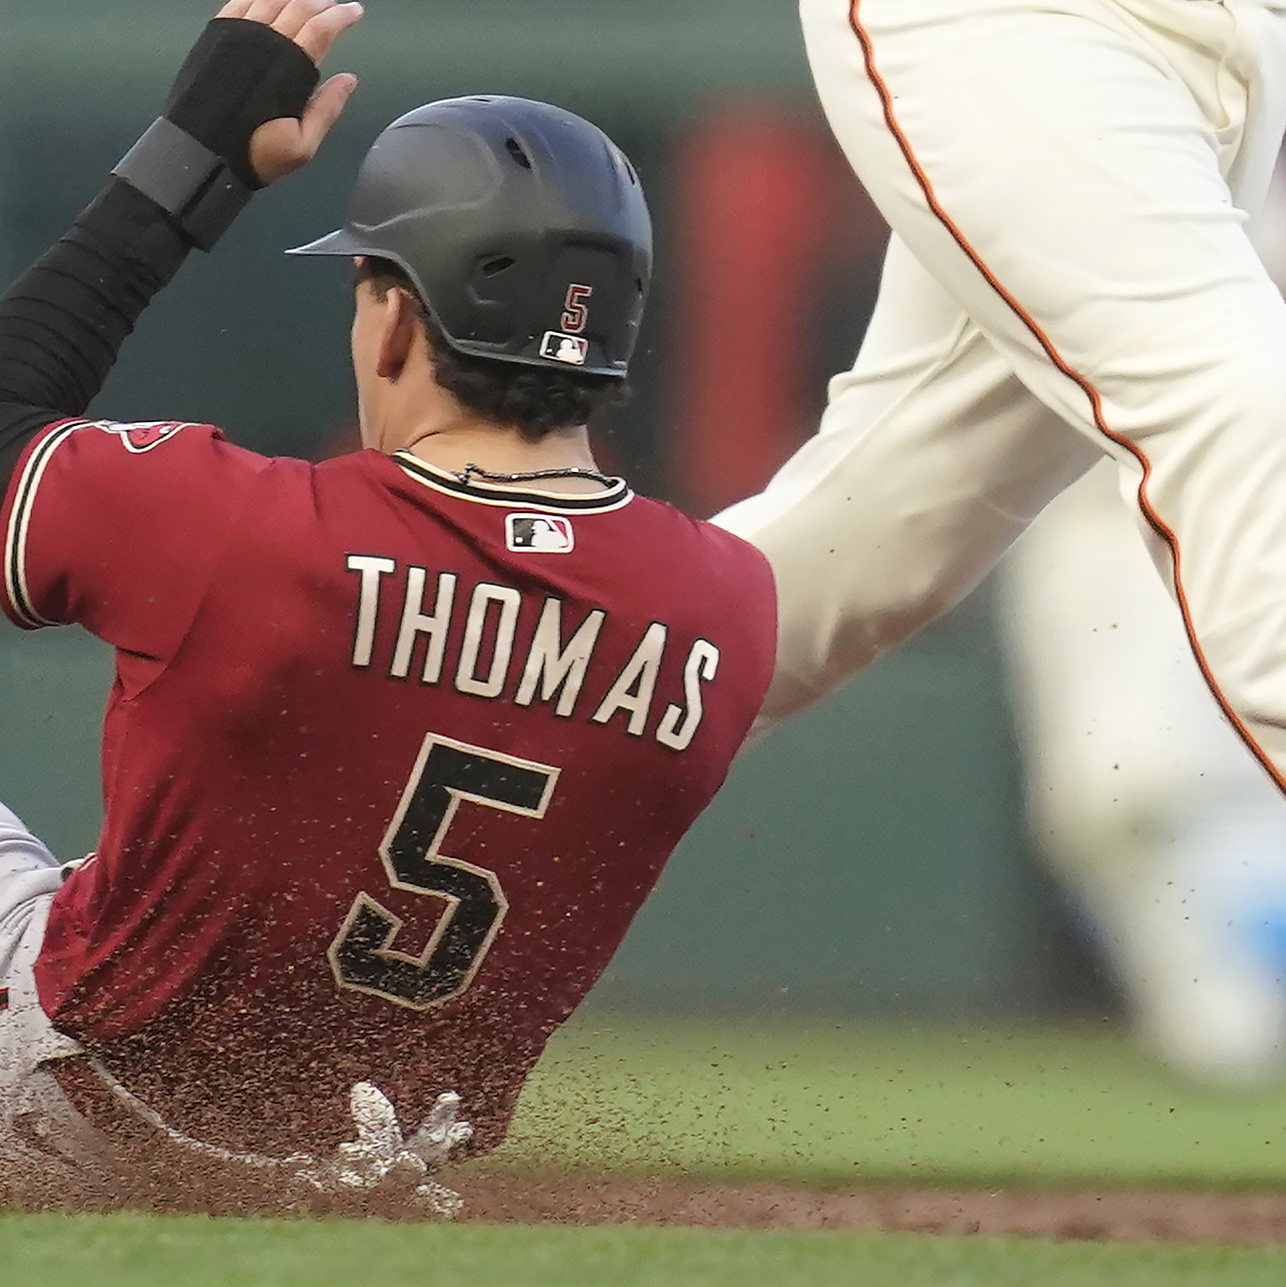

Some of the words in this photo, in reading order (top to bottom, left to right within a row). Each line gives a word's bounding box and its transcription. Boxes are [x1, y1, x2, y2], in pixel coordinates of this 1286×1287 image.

[561, 283, 593, 334] 5
[344, 551, 722, 753] THOMAS
[327, 731, 562, 1013] 5
